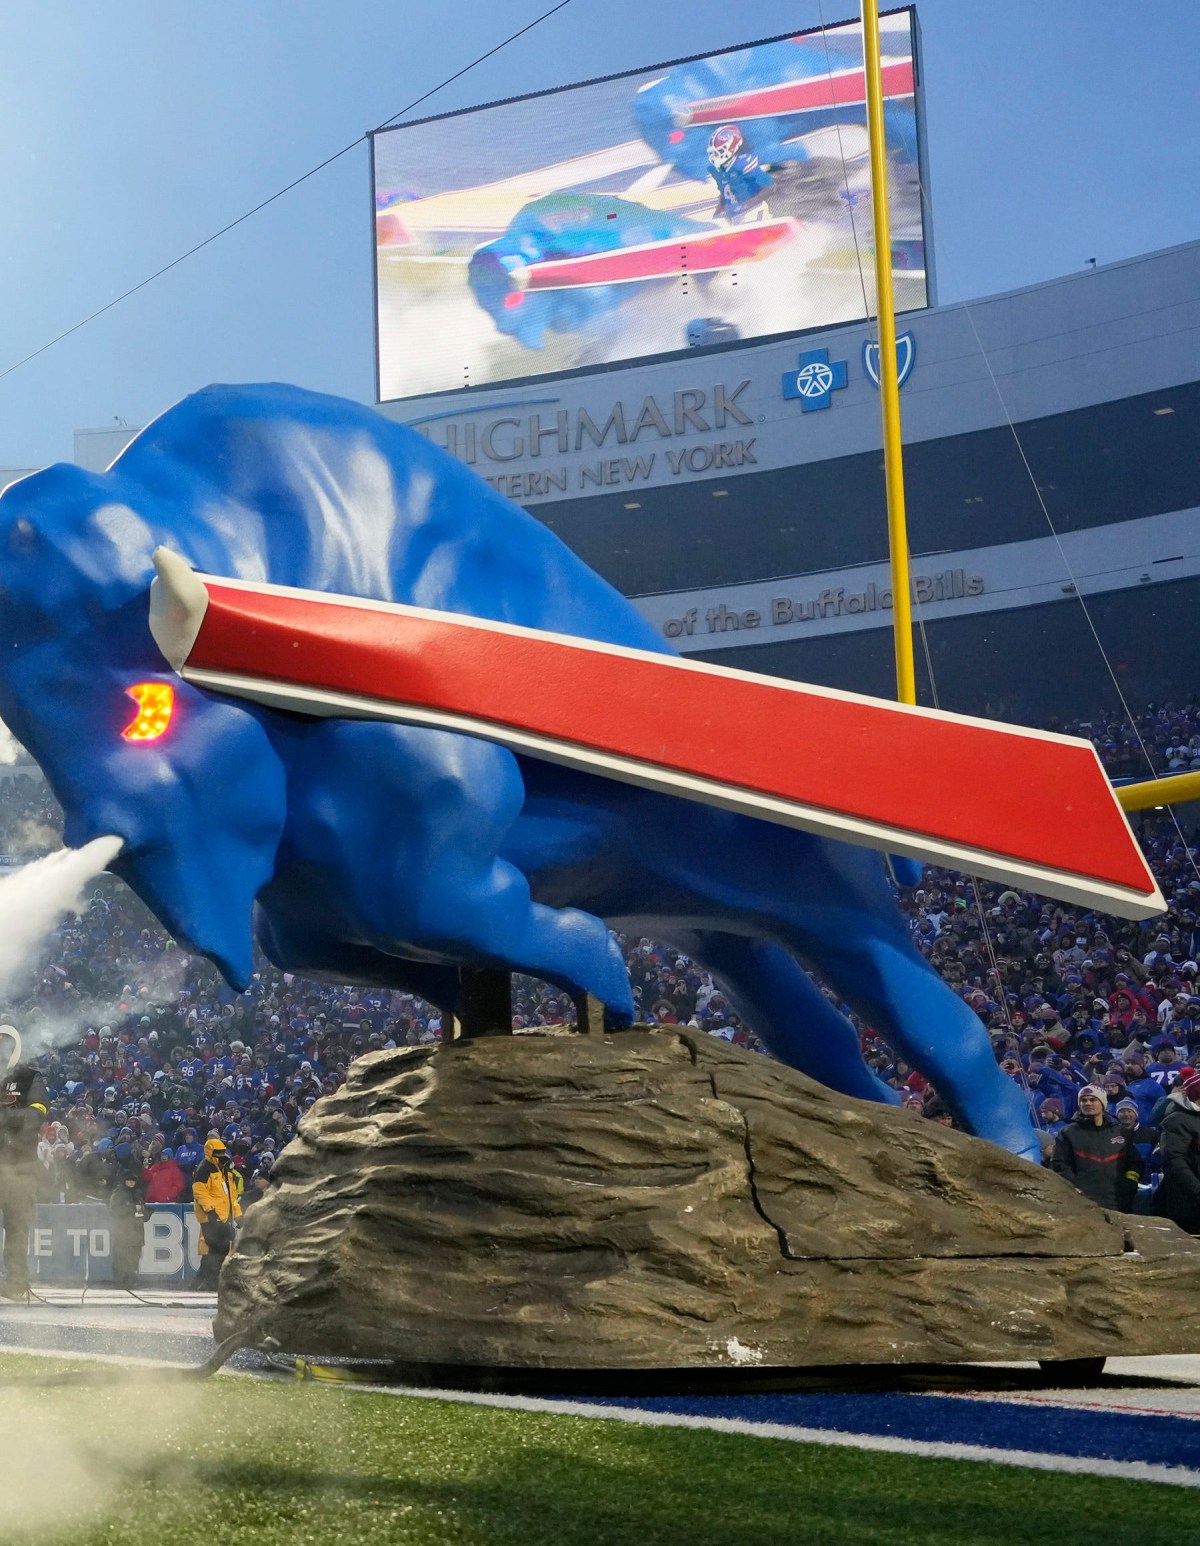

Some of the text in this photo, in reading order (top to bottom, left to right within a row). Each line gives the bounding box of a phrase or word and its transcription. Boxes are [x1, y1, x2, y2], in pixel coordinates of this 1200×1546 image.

[486, 438, 758, 498] TERN NEW YORK
[662, 568, 985, 638] of the Buffalo Bills
[1150, 1070, 1180, 1085] 78
[66, 1228, 110, 1257] TO
